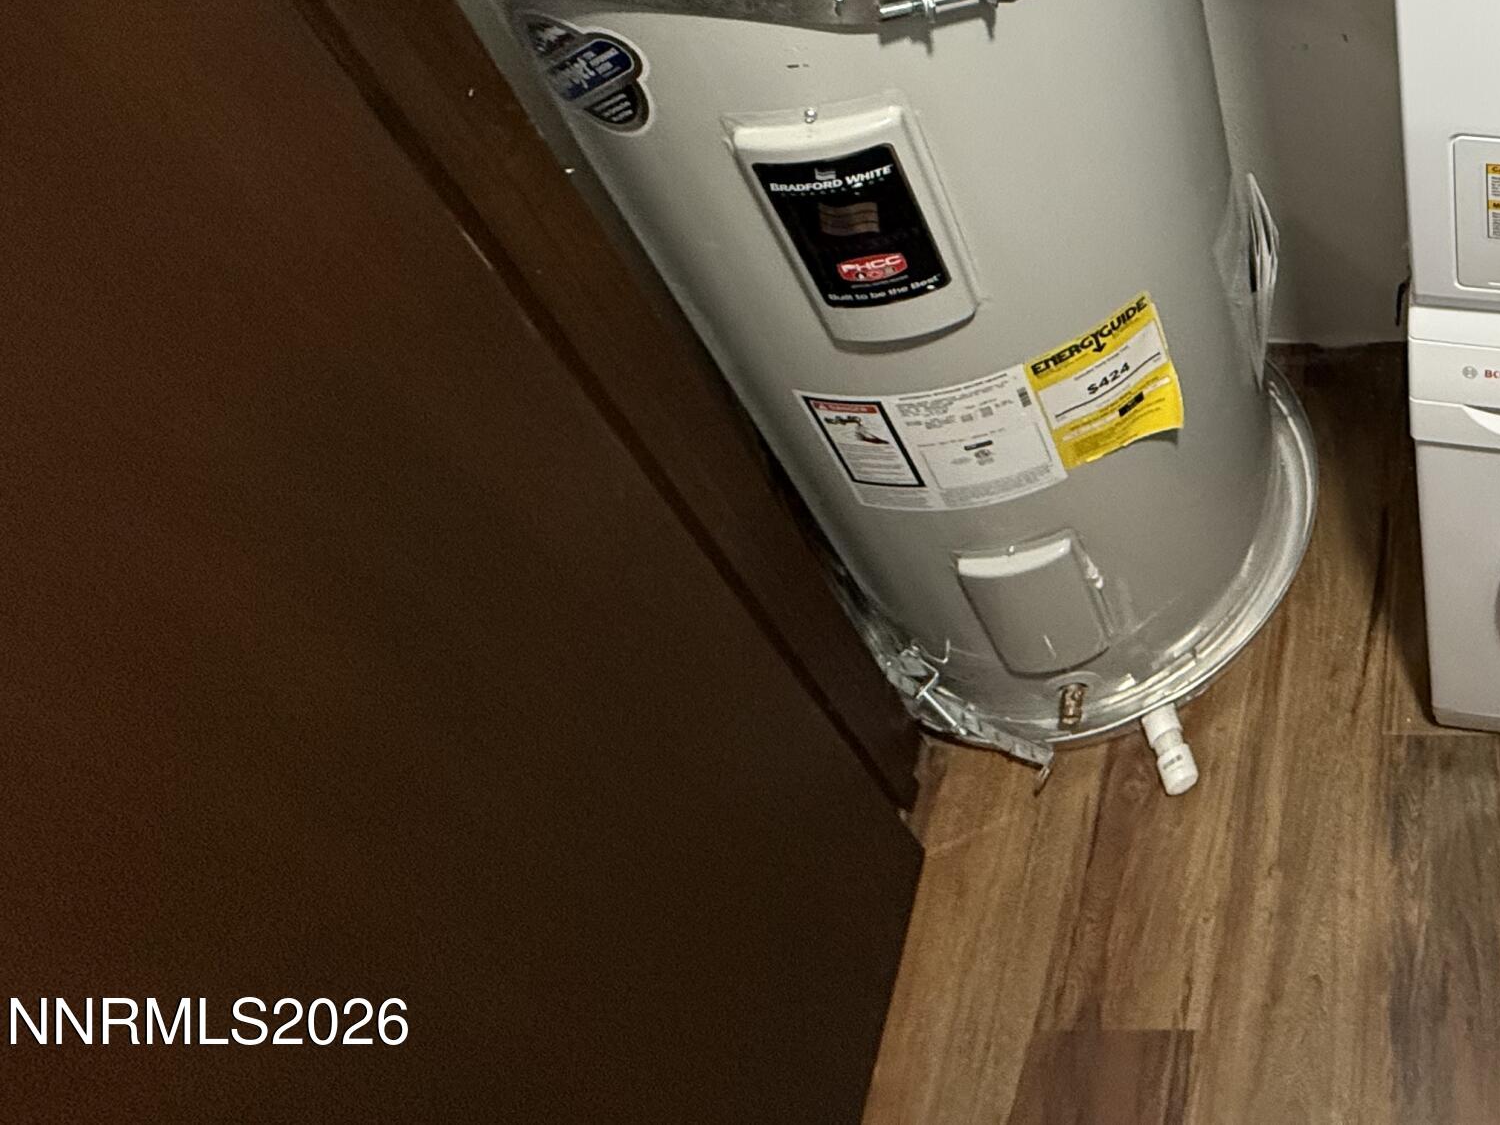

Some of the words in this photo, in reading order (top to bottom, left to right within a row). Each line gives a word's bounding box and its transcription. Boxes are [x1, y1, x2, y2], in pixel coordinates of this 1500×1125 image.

[769, 178, 843, 193] BRADFORD
[845, 164, 893, 184] WHITE
[888, 285, 909, 295] the
[910, 275, 939, 290] Best
